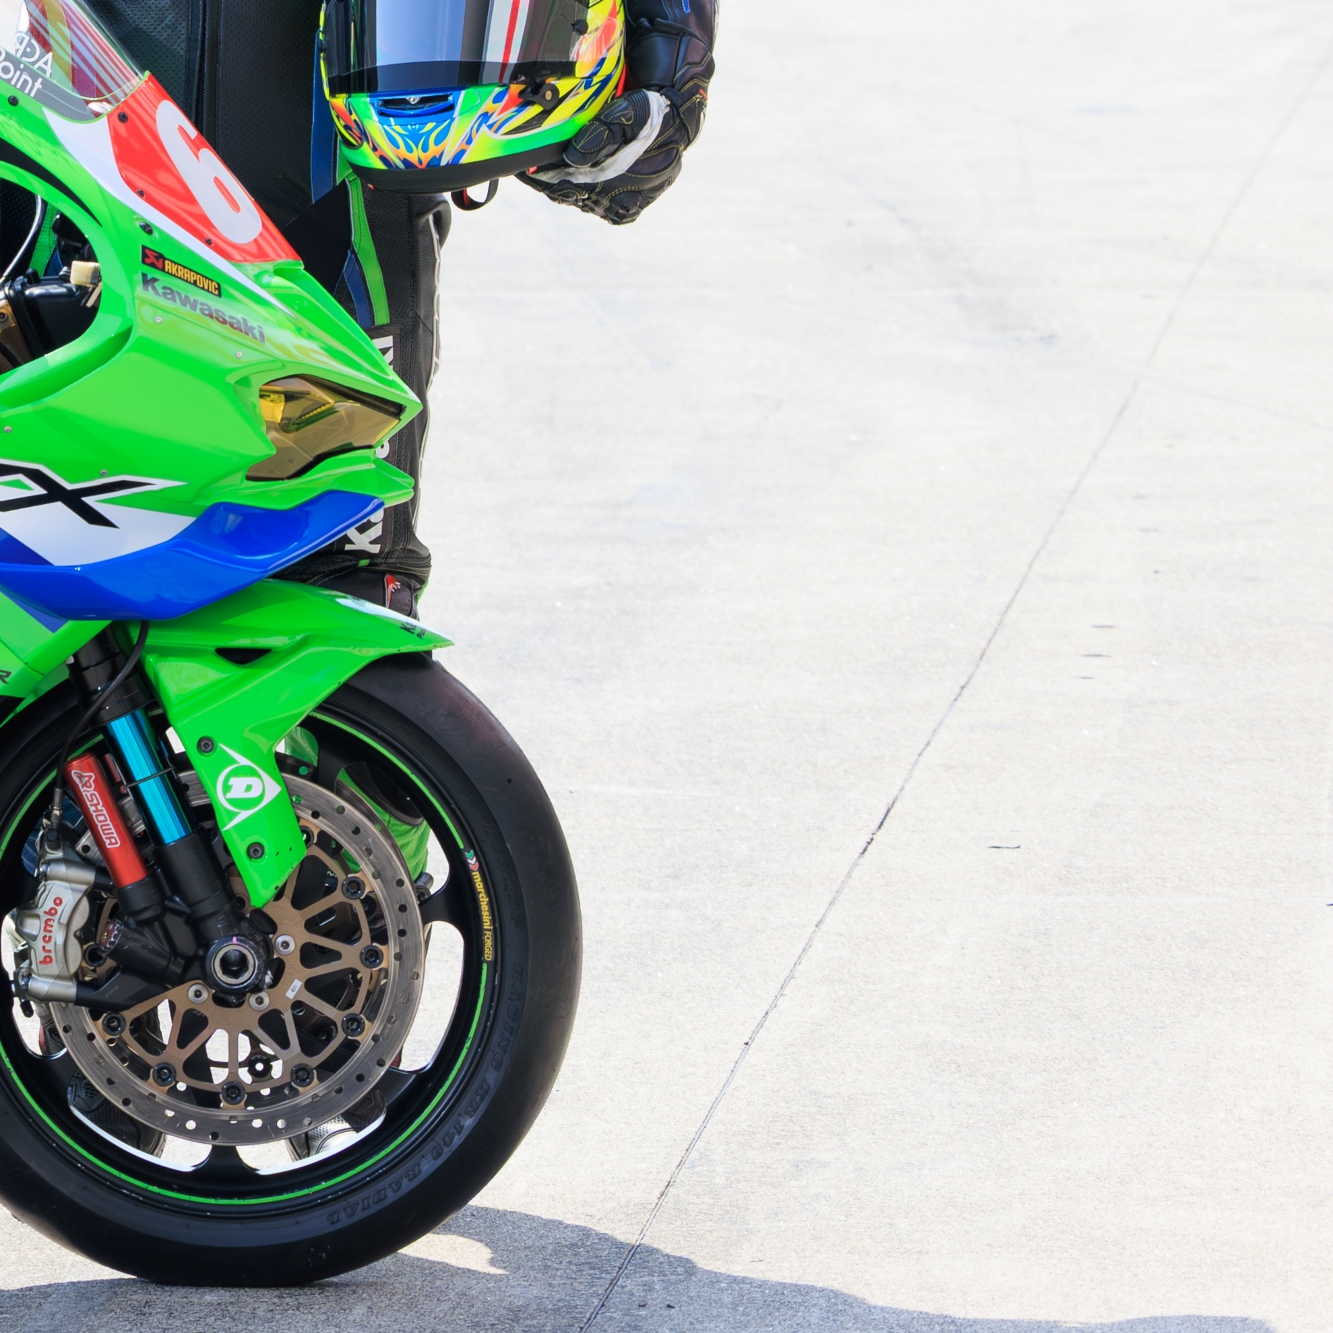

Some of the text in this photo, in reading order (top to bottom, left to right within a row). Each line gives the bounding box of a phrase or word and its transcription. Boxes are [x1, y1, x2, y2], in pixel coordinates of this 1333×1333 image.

[156, 99, 262, 245] 6
[140, 271, 266, 344] Kawasaki
[85, 790, 121, 849] SHOWA
[39, 896, 63, 966] brembo
[471, 870, 494, 962] marchesini FORGED
